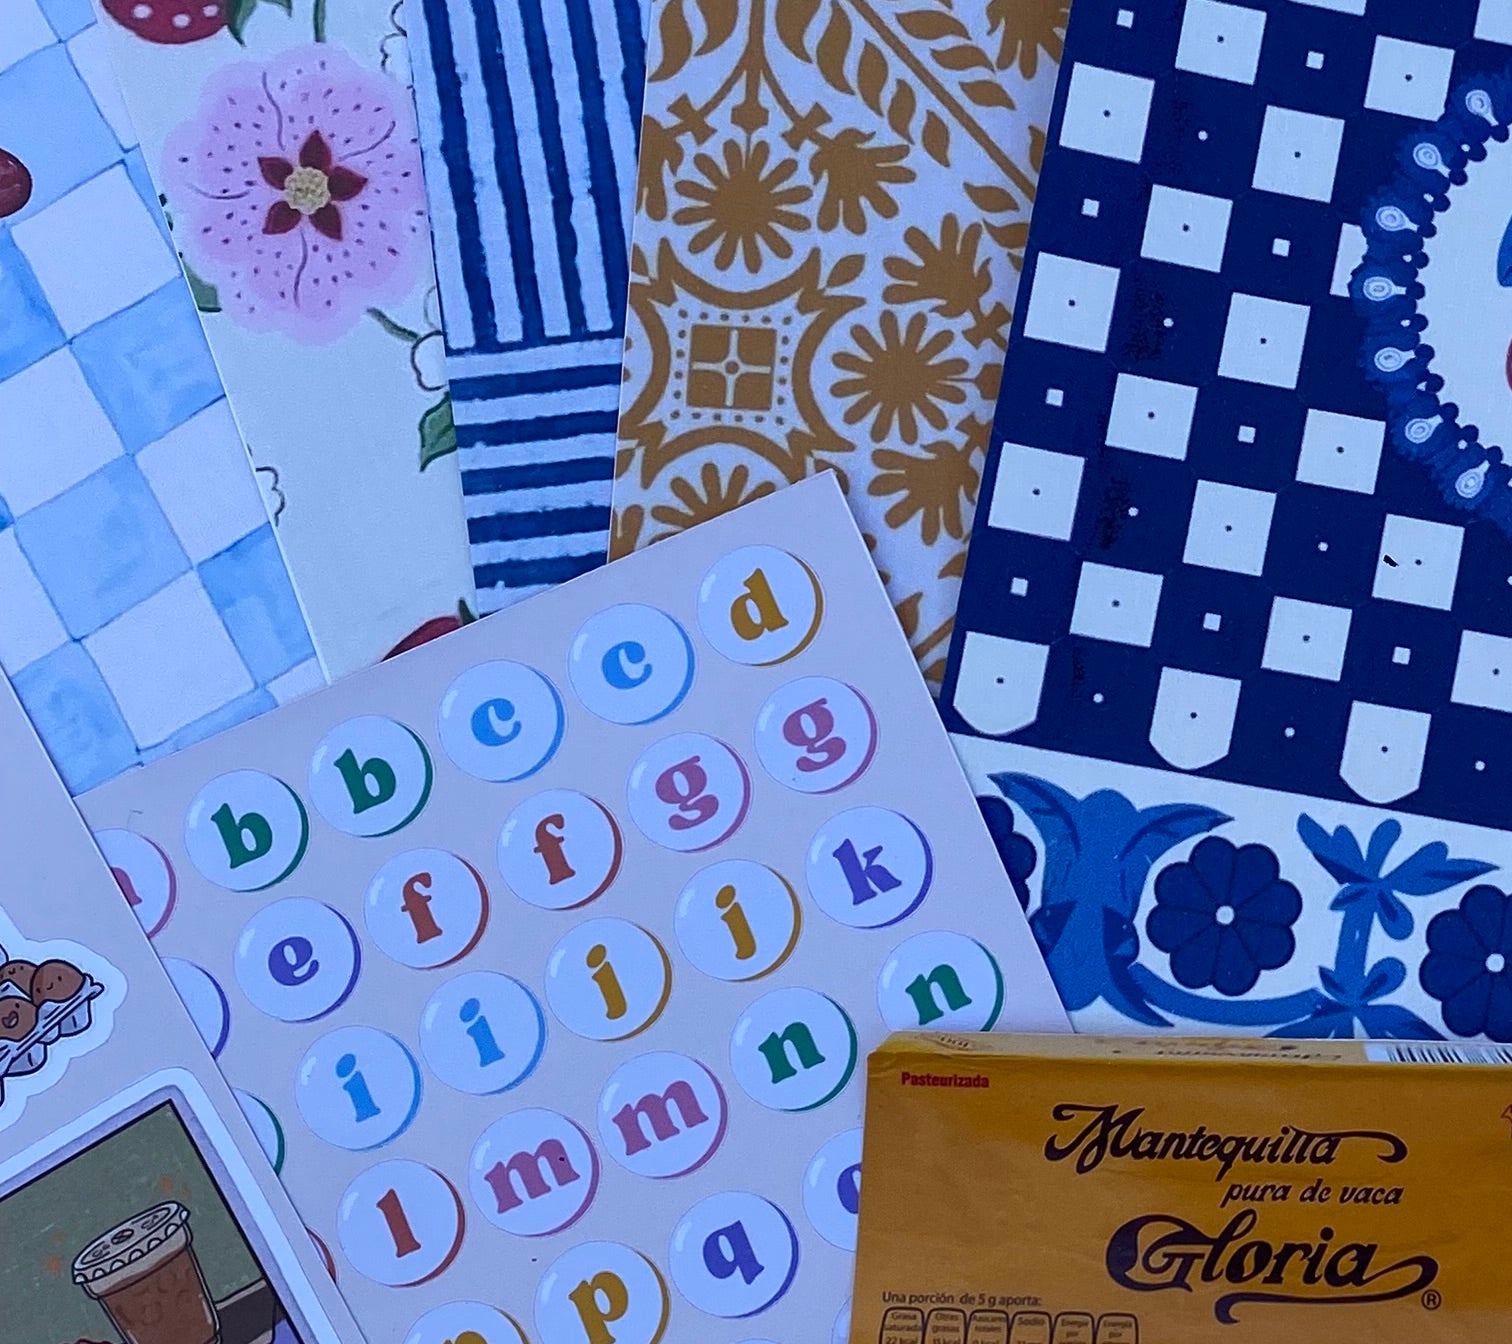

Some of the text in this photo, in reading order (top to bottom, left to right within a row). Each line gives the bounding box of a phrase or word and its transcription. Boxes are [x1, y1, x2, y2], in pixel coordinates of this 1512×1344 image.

[210, 568, 789, 869] b b c c d
[268, 697, 844, 986] e f f g g
[335, 838, 902, 1123] i i j j k
[483, 964, 972, 1214] m m n n
[901, 1071, 989, 1088] Pasteurizada
[1044, 1104, 1407, 1182] Mantequilla
[1220, 1179, 1404, 1208] pura de vaca
[702, 1219, 764, 1285] q
[882, 1291, 906, 1303] Una
[908, 1292, 954, 1305] porción
[959, 1293, 975, 1305] de
[998, 1296, 1041, 1306] aporta:
[1105, 1208, 1438, 1324] Gloria
